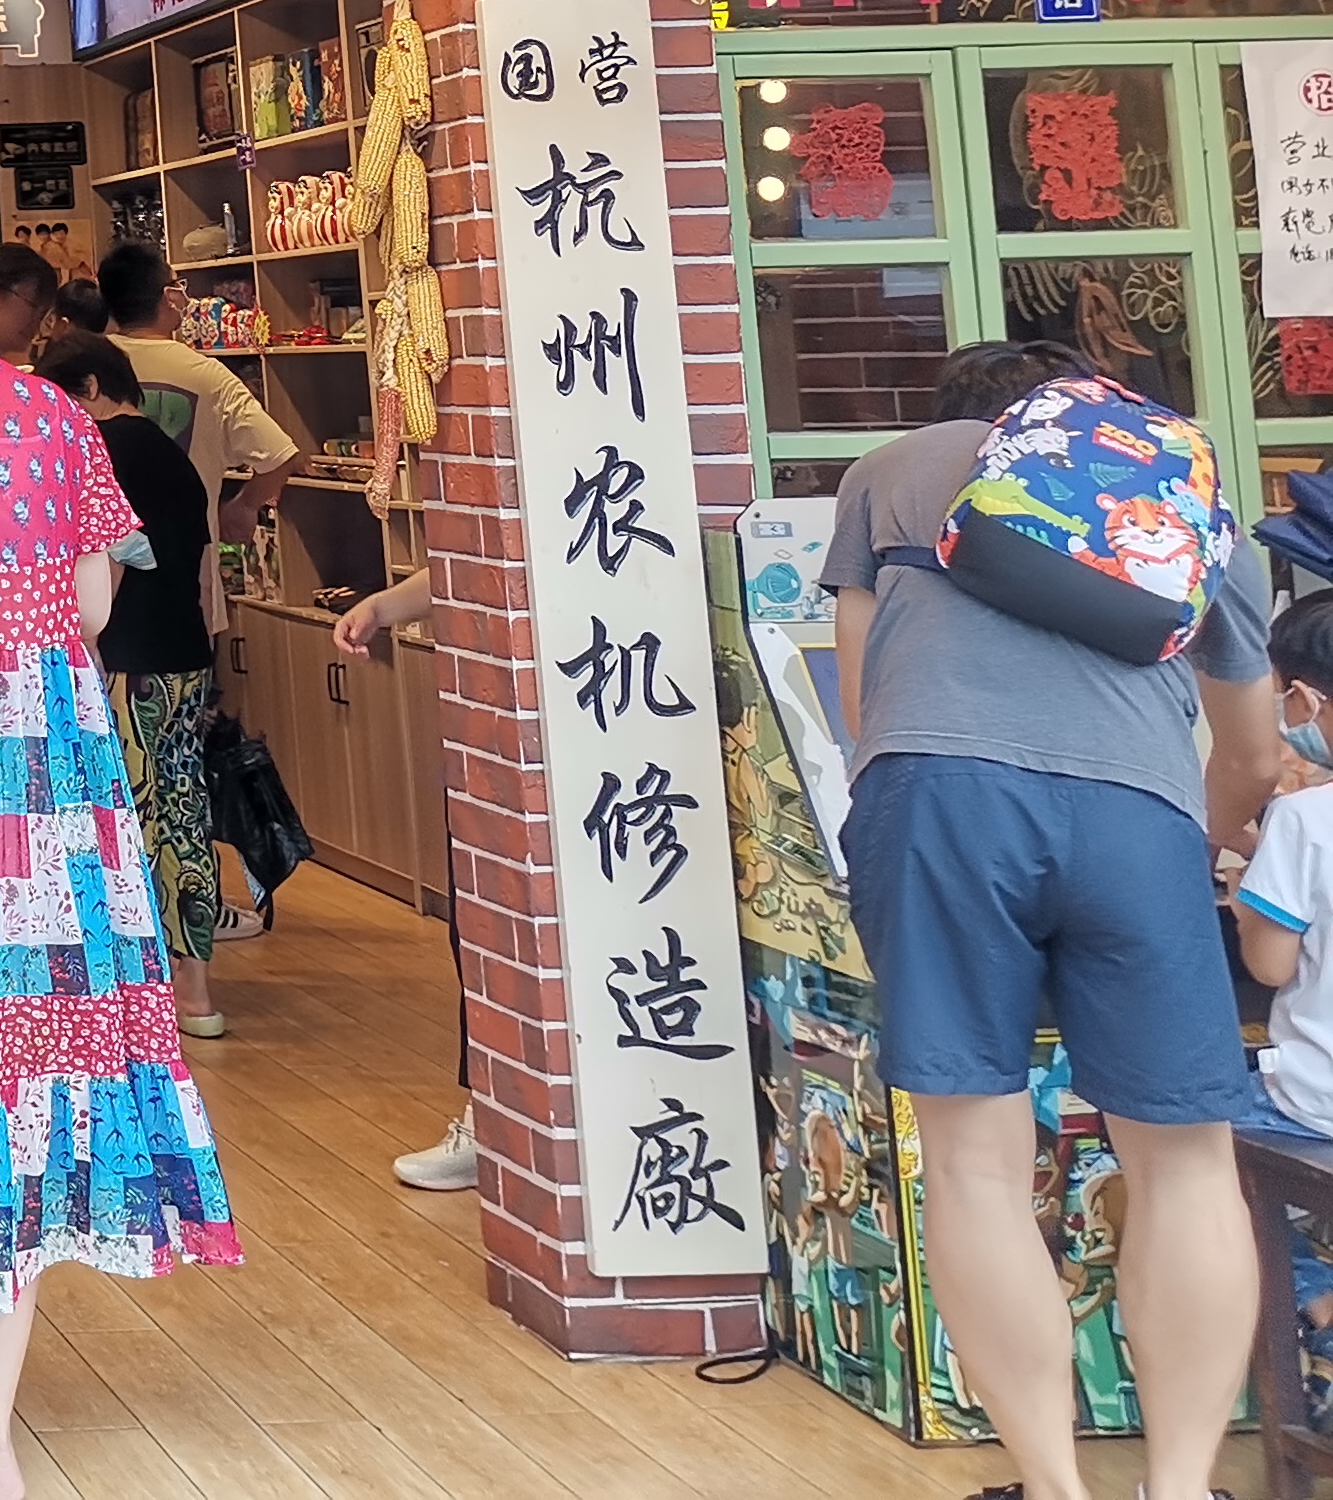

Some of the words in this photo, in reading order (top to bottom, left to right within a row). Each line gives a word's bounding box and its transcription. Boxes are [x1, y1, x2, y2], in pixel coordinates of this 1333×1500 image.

[501, 33, 638, 107] 国营
[1094, 421, 1159, 457] ZOO
[515, 143, 747, 1236] 杭州农机修造廠
